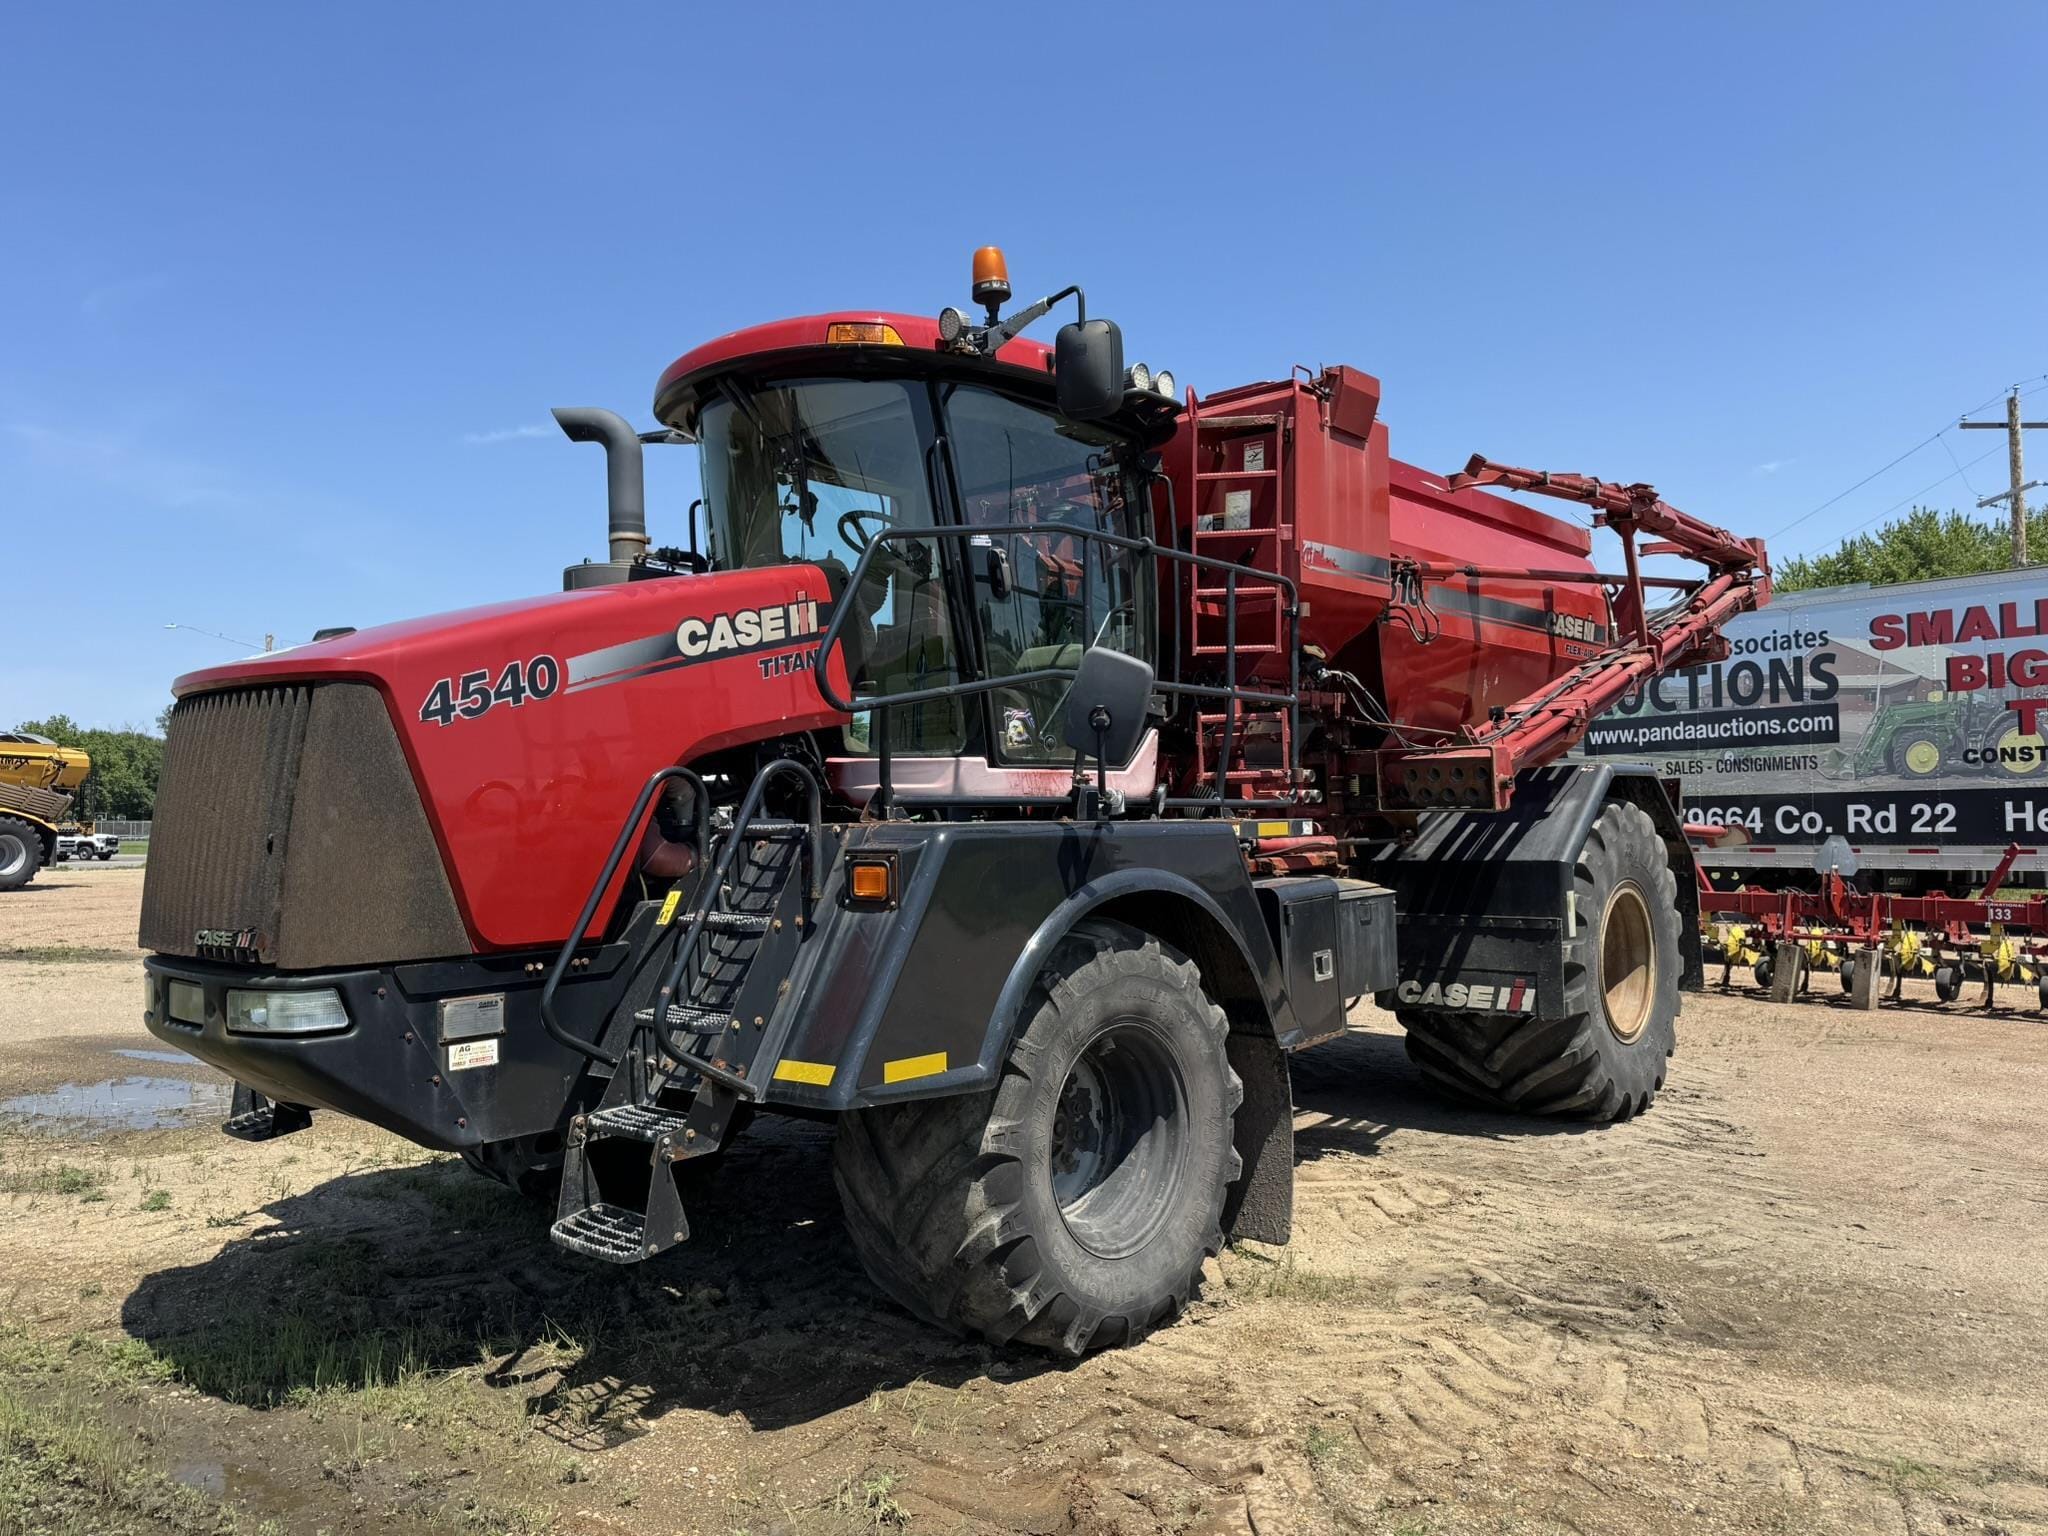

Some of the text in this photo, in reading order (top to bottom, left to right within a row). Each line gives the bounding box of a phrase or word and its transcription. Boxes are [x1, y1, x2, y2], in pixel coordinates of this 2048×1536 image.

[757, 647, 819, 679] TITAN
[1946, 649, 2048, 692] BIG
[419, 654, 559, 727] 4540
[1588, 715, 1833, 746] www.pandaauctions.com
[1666, 761, 1703, 775] SALES
[1716, 755, 1818, 773] CONSIGNMENTS
[1683, 806, 1764, 834] 9664
[1775, 804, 1833, 834] Co.
[1847, 803, 1897, 834] Rd
[1911, 803, 1957, 833] 22
[1990, 908, 2012, 920] 133
[194, 930, 233, 947] CASE
[1398, 980, 1495, 1009] CASE
